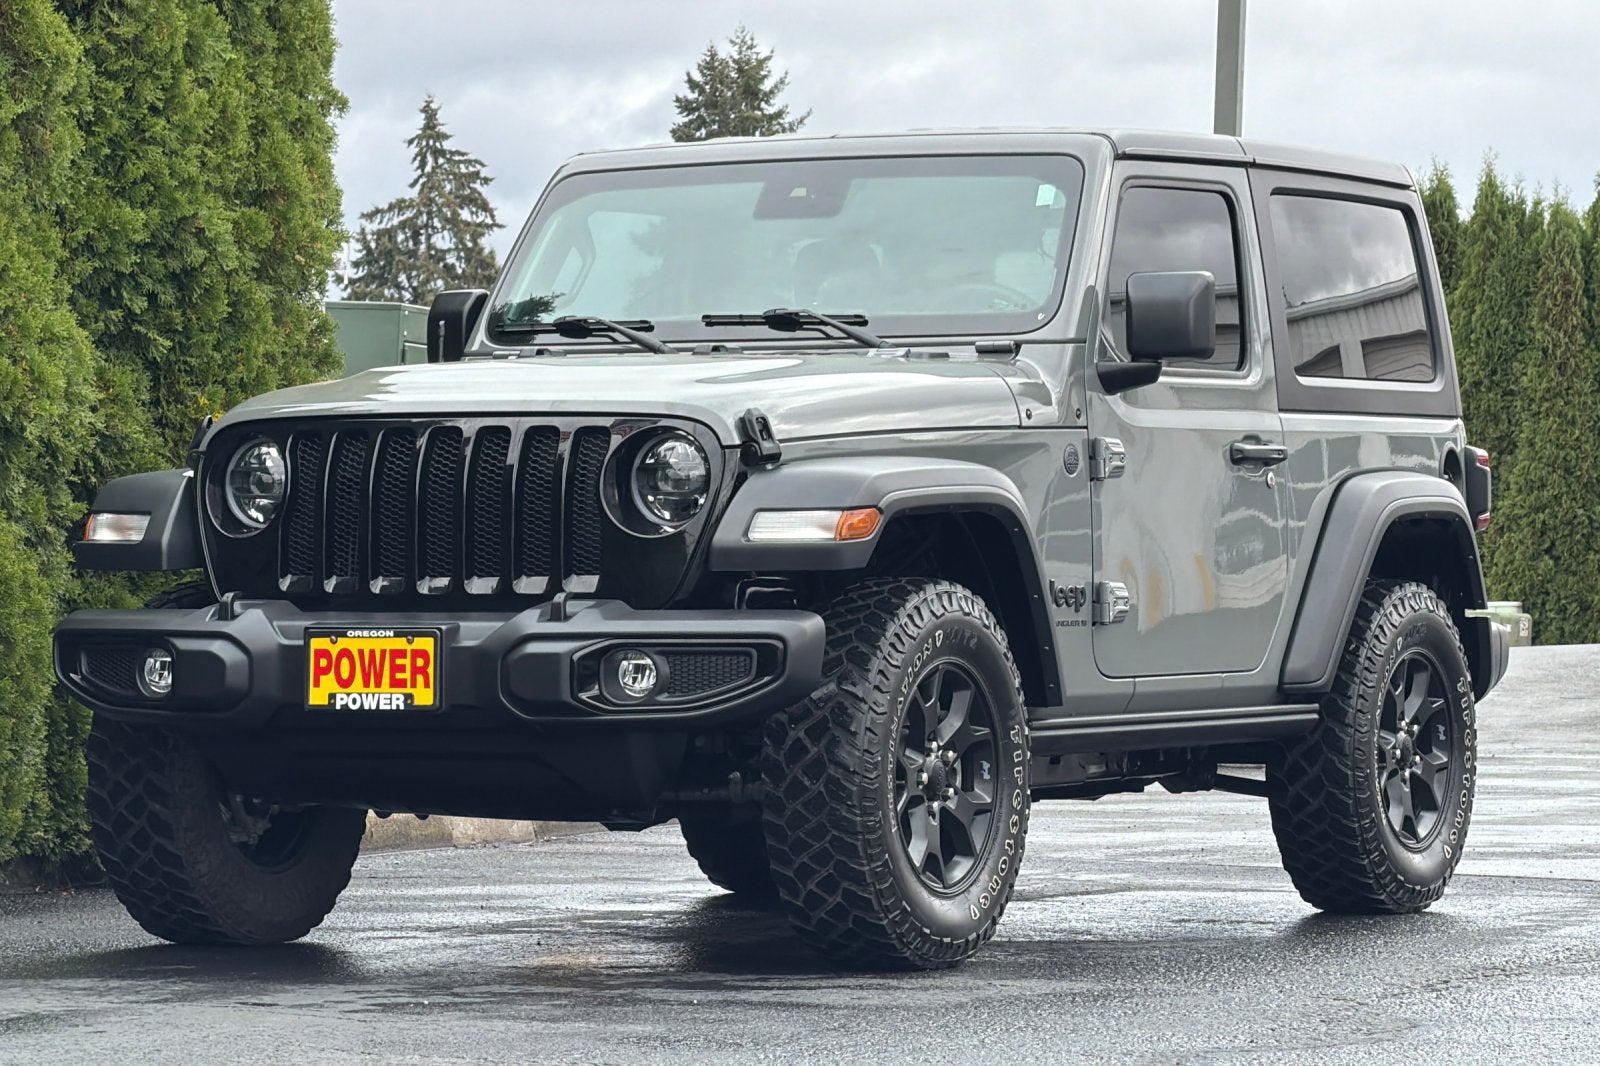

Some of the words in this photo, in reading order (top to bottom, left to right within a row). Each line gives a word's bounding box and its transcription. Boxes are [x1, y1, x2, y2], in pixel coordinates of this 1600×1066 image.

[313, 648, 430, 689] POWER
[336, 693, 405, 710] POWER
[979, 725, 1024, 908] Firestone
